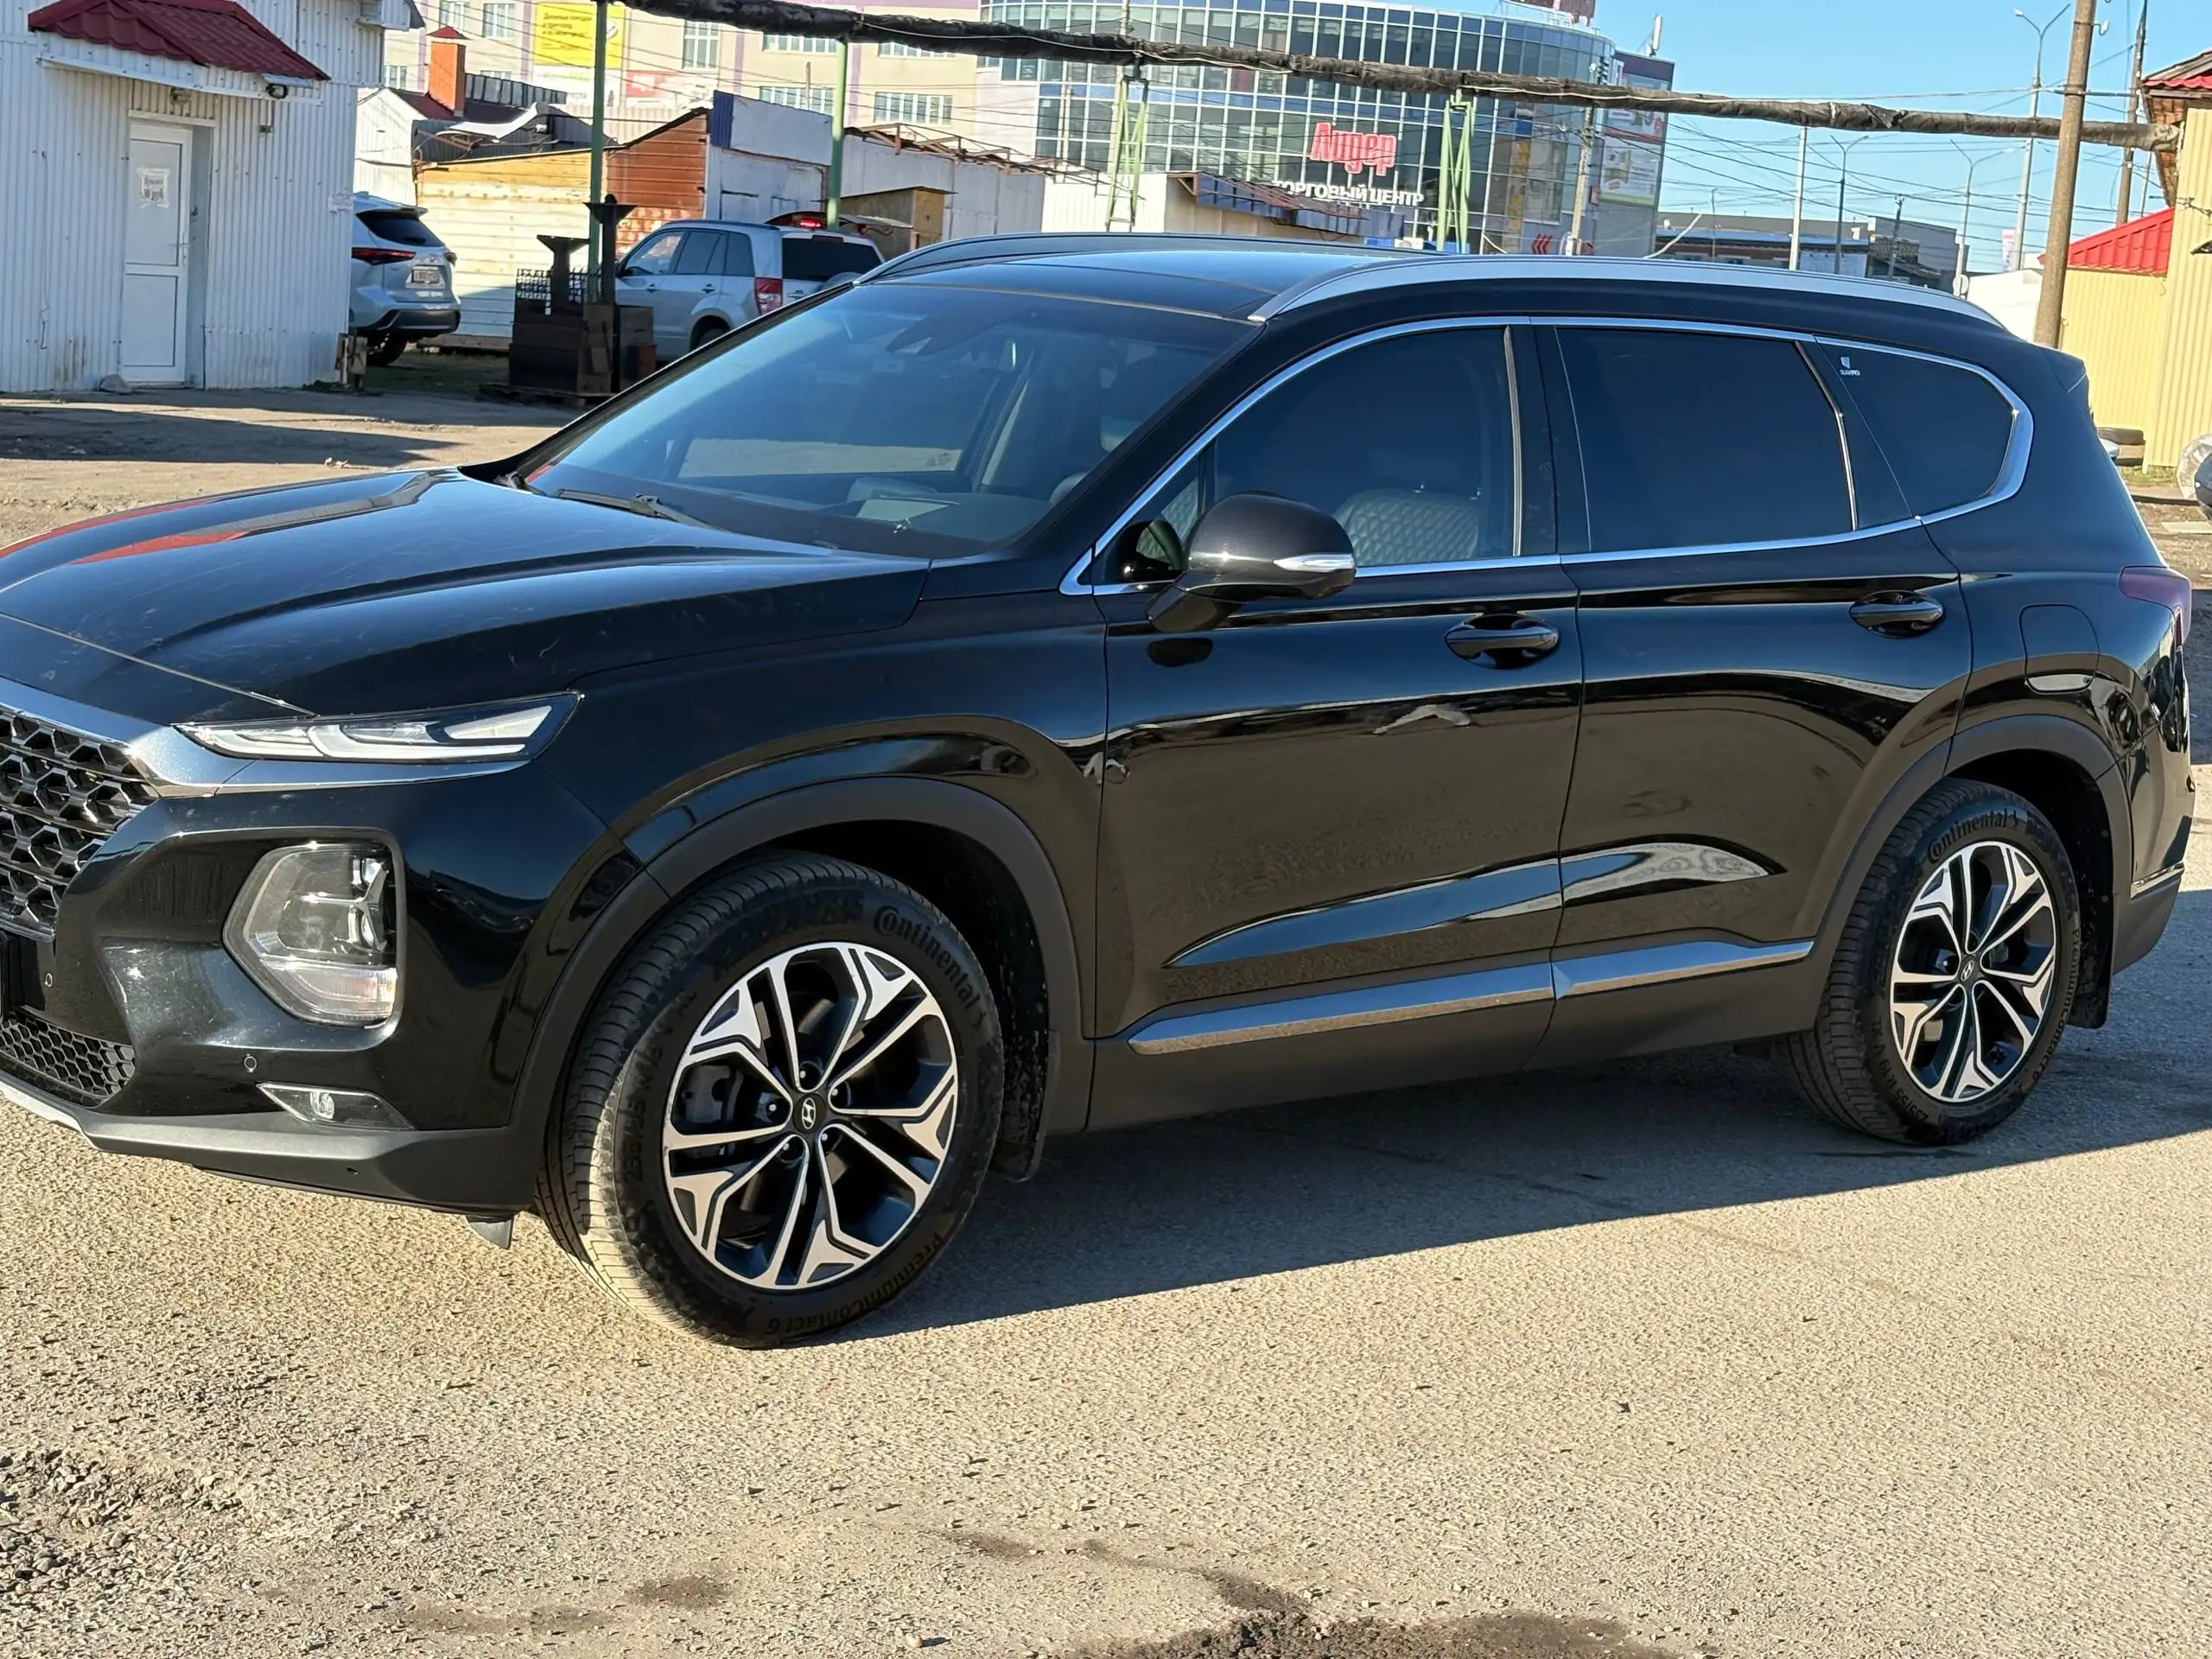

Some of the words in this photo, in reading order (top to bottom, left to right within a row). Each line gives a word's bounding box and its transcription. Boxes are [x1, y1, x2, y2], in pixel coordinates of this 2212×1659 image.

[1310, 122, 1397, 176] Лидер
[1370, 188, 1425, 207] ЦЕНТР
[1927, 808, 2009, 864] Continental
[874, 904, 981, 1011] Continental
[785, 1230, 945, 1335] PremiumContact
[764, 1318, 781, 1335] 6
